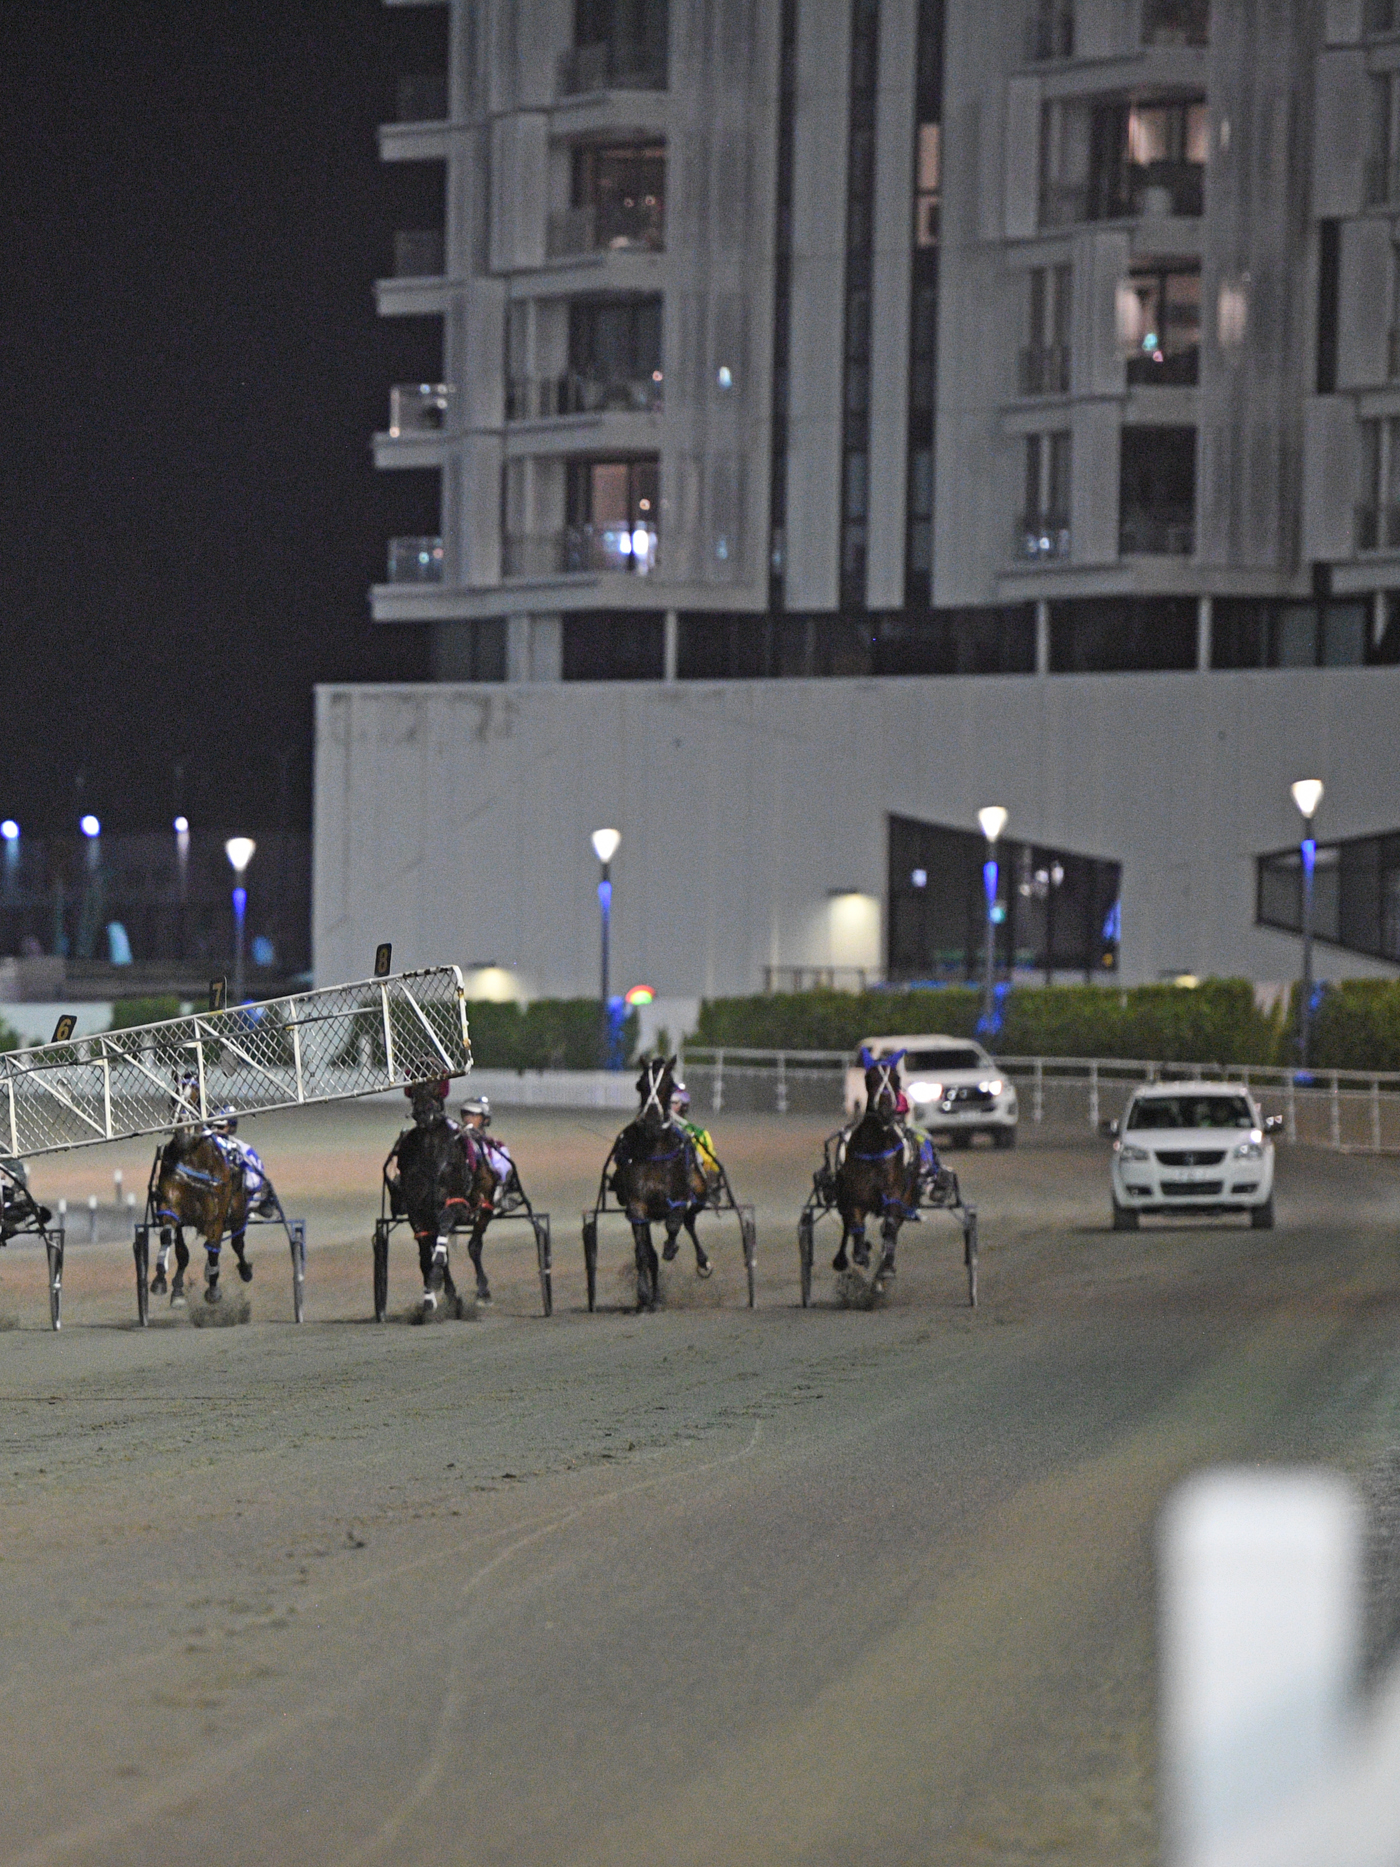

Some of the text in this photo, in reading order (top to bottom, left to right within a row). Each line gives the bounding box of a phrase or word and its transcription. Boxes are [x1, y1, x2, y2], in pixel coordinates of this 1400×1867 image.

[377, 948, 389, 974] 8
[212, 981, 224, 1007] 7
[56, 1018, 72, 1041] 6
